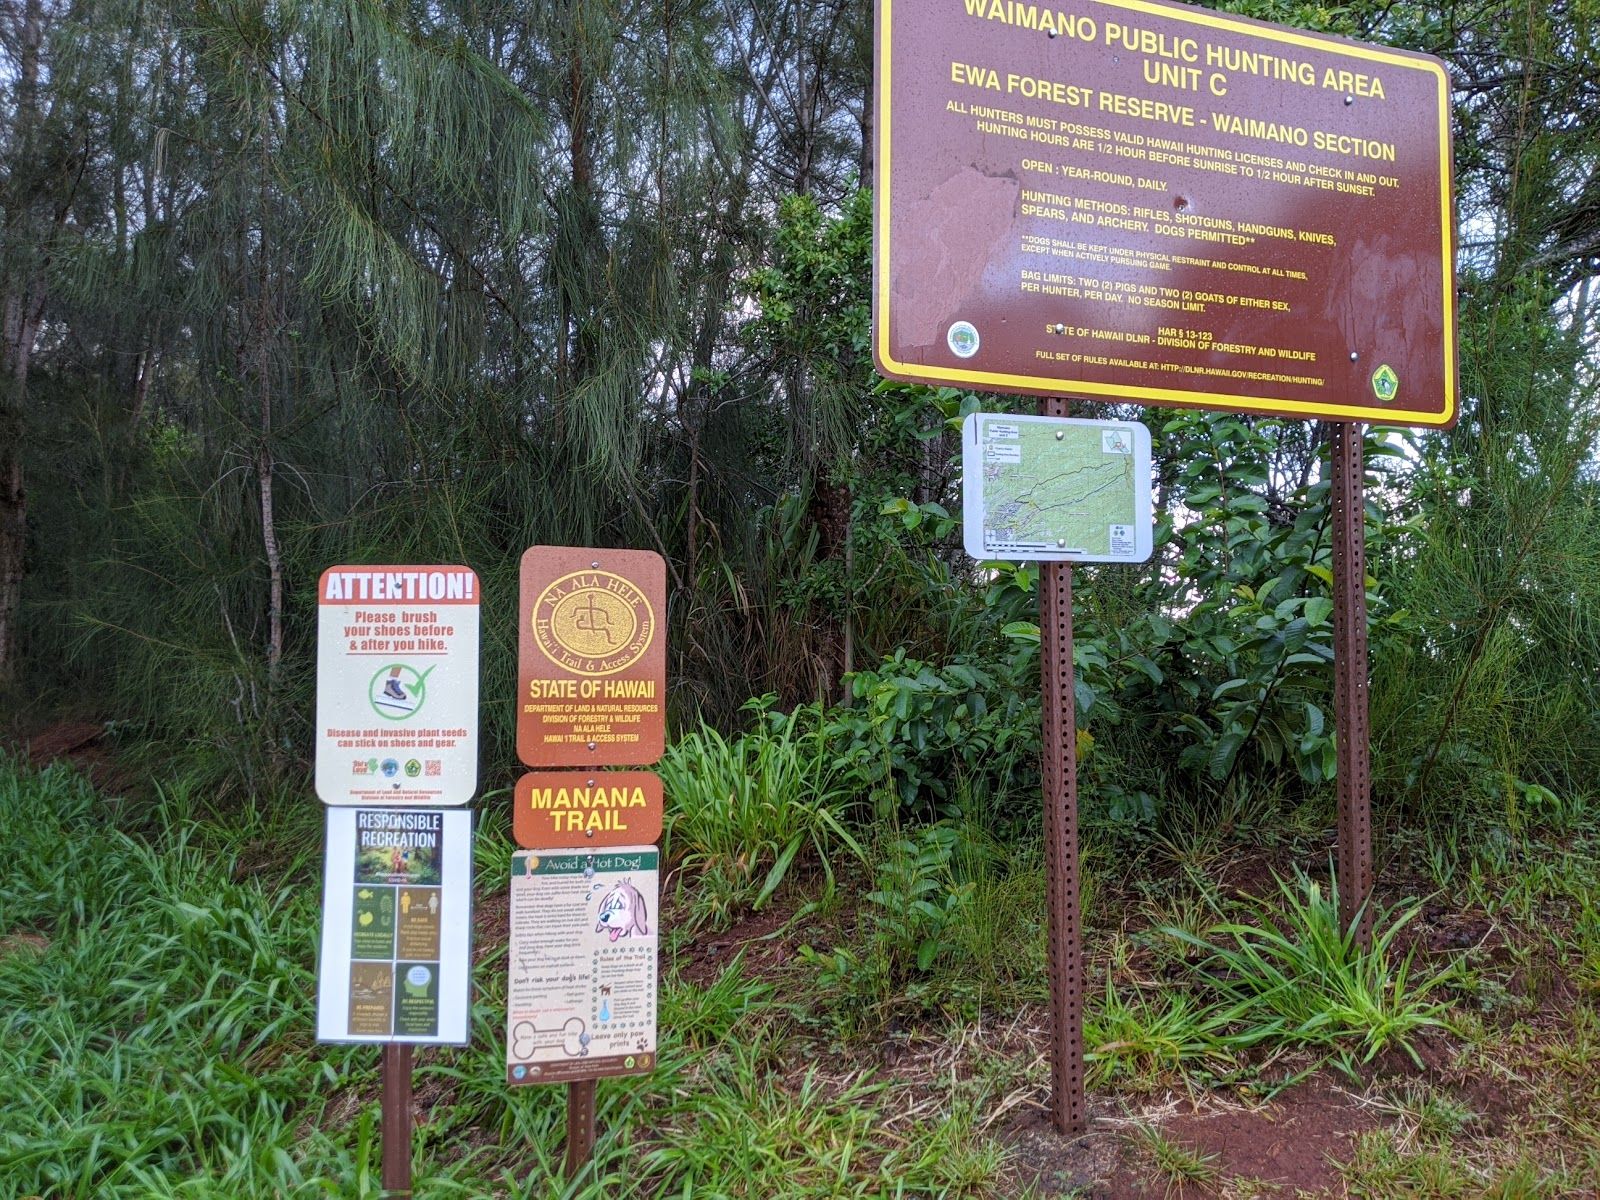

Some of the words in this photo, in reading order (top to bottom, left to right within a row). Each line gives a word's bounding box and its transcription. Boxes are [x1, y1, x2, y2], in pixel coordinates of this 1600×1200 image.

[964, 0, 1096, 41] WAIMANO
[1105, 22, 1198, 62] PUBLIC
[1206, 43, 1315, 86] HUNTING
[1322, 68, 1385, 99] AREA
[1144, 59, 1202, 91] UNIT
[1209, 73, 1227, 96] C
[951, 62, 1000, 90] EWA
[1007, 73, 1093, 107] FOREST
[1099, 91, 1194, 126] RESERVE
[1211, 112, 1307, 146] WAIMANO
[1313, 131, 1395, 161] SECTION
[946, 100, 967, 113] ALL
[970, 104, 1023, 124] HUNTERS
[1026, 115, 1057, 130] MUST
[1060, 121, 1111, 140] POSSESS
[1113, 131, 1144, 145] VALID
[1146, 137, 1183, 152] HAWAII
[1186, 143, 1232, 160] HUNTING
[1235, 152, 1283, 169] LICENSES
[1285, 160, 1306, 172] AND
[1308, 164, 1342, 179] CHECK
[1344, 170, 1354, 180] IN
[1356, 172, 1376, 184] AND
[1378, 175, 1399, 188] OUT.
[977, 120, 1027, 139] HUNTING
[1030, 130, 1069, 146] HOURS
[1072, 138, 1094, 151] ARE
[1097, 142, 1112, 154] 1/2
[1115, 145, 1145, 159] HOUR
[1148, 151, 1190, 166] BEFORE
[1193, 158, 1237, 174] SUNRISE
[1239, 165, 1253, 177] TO
[1257, 169, 1270, 179] 1/2
[1272, 171, 1301, 184] HOUR
[1303, 176, 1334, 190] AFTER
[1336, 181, 1375, 196] SUNSET.
[1022, 158, 1052, 173] OPEN
[1061, 165, 1134, 188] YEAR-ROUND,
[1137, 177, 1167, 191] DAILY.
[1021, 203, 1068, 222] SPEARS,
[1071, 211, 1094, 224] AND
[1097, 215, 1149, 232] ARCHERY.
[1154, 223, 1185, 237] DOGS
[1022, 190, 1071, 206] HUNTING
[1075, 198, 1130, 215] METHODS:
[1133, 207, 1172, 223] RIFLES,
[1175, 213, 1235, 232] SHOTGUNS,
[1237, 222, 1296, 241] HANDGUNS,
[1298, 230, 1336, 246] KNIVES,
[1021, 243, 1050, 254] EXCEPT
[1051, 247, 1074, 257] WHEN
[1075, 251, 1109, 261] ACTIVELY
[1110, 255, 1147, 267] PURSUING
[1052, 239, 1075, 248] SHALL
[1109, 248, 1133, 256] UNDER
[1135, 251, 1170, 261] PHYSICAL
[1172, 255, 1210, 266] RESTRAINT
[1227, 262, 1261, 273] CONTROL
[1285, 270, 1308, 280] TIMES,
[1021, 282, 1039, 292] PER
[1042, 284, 1082, 298] HUNTER,
[1084, 290, 1102, 300] PER
[1105, 292, 1123, 302] DAY.
[1128, 295, 1141, 304] NO
[1143, 297, 1179, 309] SEASON
[1182, 301, 1206, 312] LIMIT.
[1022, 270, 1040, 280] BAG
[1043, 273, 1075, 284] LIMITS:
[1078, 277, 1098, 287] TWO
[1101, 281, 1112, 291] (2)
[1115, 282, 1136, 292] PIGS
[1139, 285, 1157, 294] AND
[1159, 287, 1179, 297] TWO
[1182, 290, 1192, 301] (2)
[1195, 292, 1224, 303] GOATS
[1226, 295, 1238, 304] OF
[1240, 297, 1270, 308] EITHER
[1272, 300, 1290, 312] SEX,
[1076, 327, 1089, 336] OF
[1091, 329, 1123, 340] HAWAII
[1126, 333, 1150, 343] DLNR
[1157, 336, 1195, 348] DIVISION
[1197, 340, 1210, 349] OF
[1211, 342, 1256, 354] FORESTRY
[1257, 347, 1276, 356] AND
[1277, 349, 1316, 361] WILDLIFE
[1158, 327, 1176, 336] HAR
[1186, 330, 1212, 340] 13-123
[1035, 350, 1054, 359] FULL
[1071, 354, 1081, 362] OF
[1083, 355, 1107, 364] RULES
[1108, 358, 1147, 369] AVAILABLE
[325, 572, 474, 600] ATTENTION!
[571, 575, 601, 590] ALA
[606, 579, 643, 608] HELE
[355, 611, 396, 623] Please
[402, 611, 437, 623] brush
[344, 626, 371, 637] your
[374, 624, 410, 636] shoes
[414, 624, 454, 636] before
[349, 640, 357, 650] &
[361, 638, 389, 650] after
[393, 640, 414, 652] you
[418, 638, 447, 650] hike.
[560, 652, 582, 669] Trail
[586, 660, 595, 671] &
[599, 654, 631, 671] Access
[630, 621, 650, 654] System
[531, 680, 577, 698] STATE
[581, 680, 601, 698] OF
[605, 680, 654, 698] HAWAII
[543, 715, 568, 723] DIVISION
[578, 715, 608, 723] FORESTRY
[327, 728, 361, 738] Disease
[362, 728, 379, 738] and
[380, 728, 416, 738] invasive
[417, 728, 440, 738] plant
[441, 728, 467, 738] seeds
[337, 740, 353, 748] can
[355, 738, 376, 748] stick
[390, 738, 416, 748] shoes
[417, 738, 434, 748] and
[435, 739, 457, 749] gear.
[591, 734, 616, 743] ACCESS
[616, 734, 639, 742] SYSTEM
[532, 788, 646, 809] MANANA
[359, 813, 440, 830] RESPONSIBLE
[550, 810, 626, 831] TRAIL
[361, 831, 436, 848] RECREATION
[545, 856, 579, 870] Avoid
[615, 856, 642, 870] Dog!
[531, 976, 543, 984] risk
[546, 976, 560, 984] your
[591, 1032, 611, 1041] Leave
[613, 1032, 628, 1041] only
[630, 1031, 645, 1039] paw
[609, 1040, 630, 1049] prints
